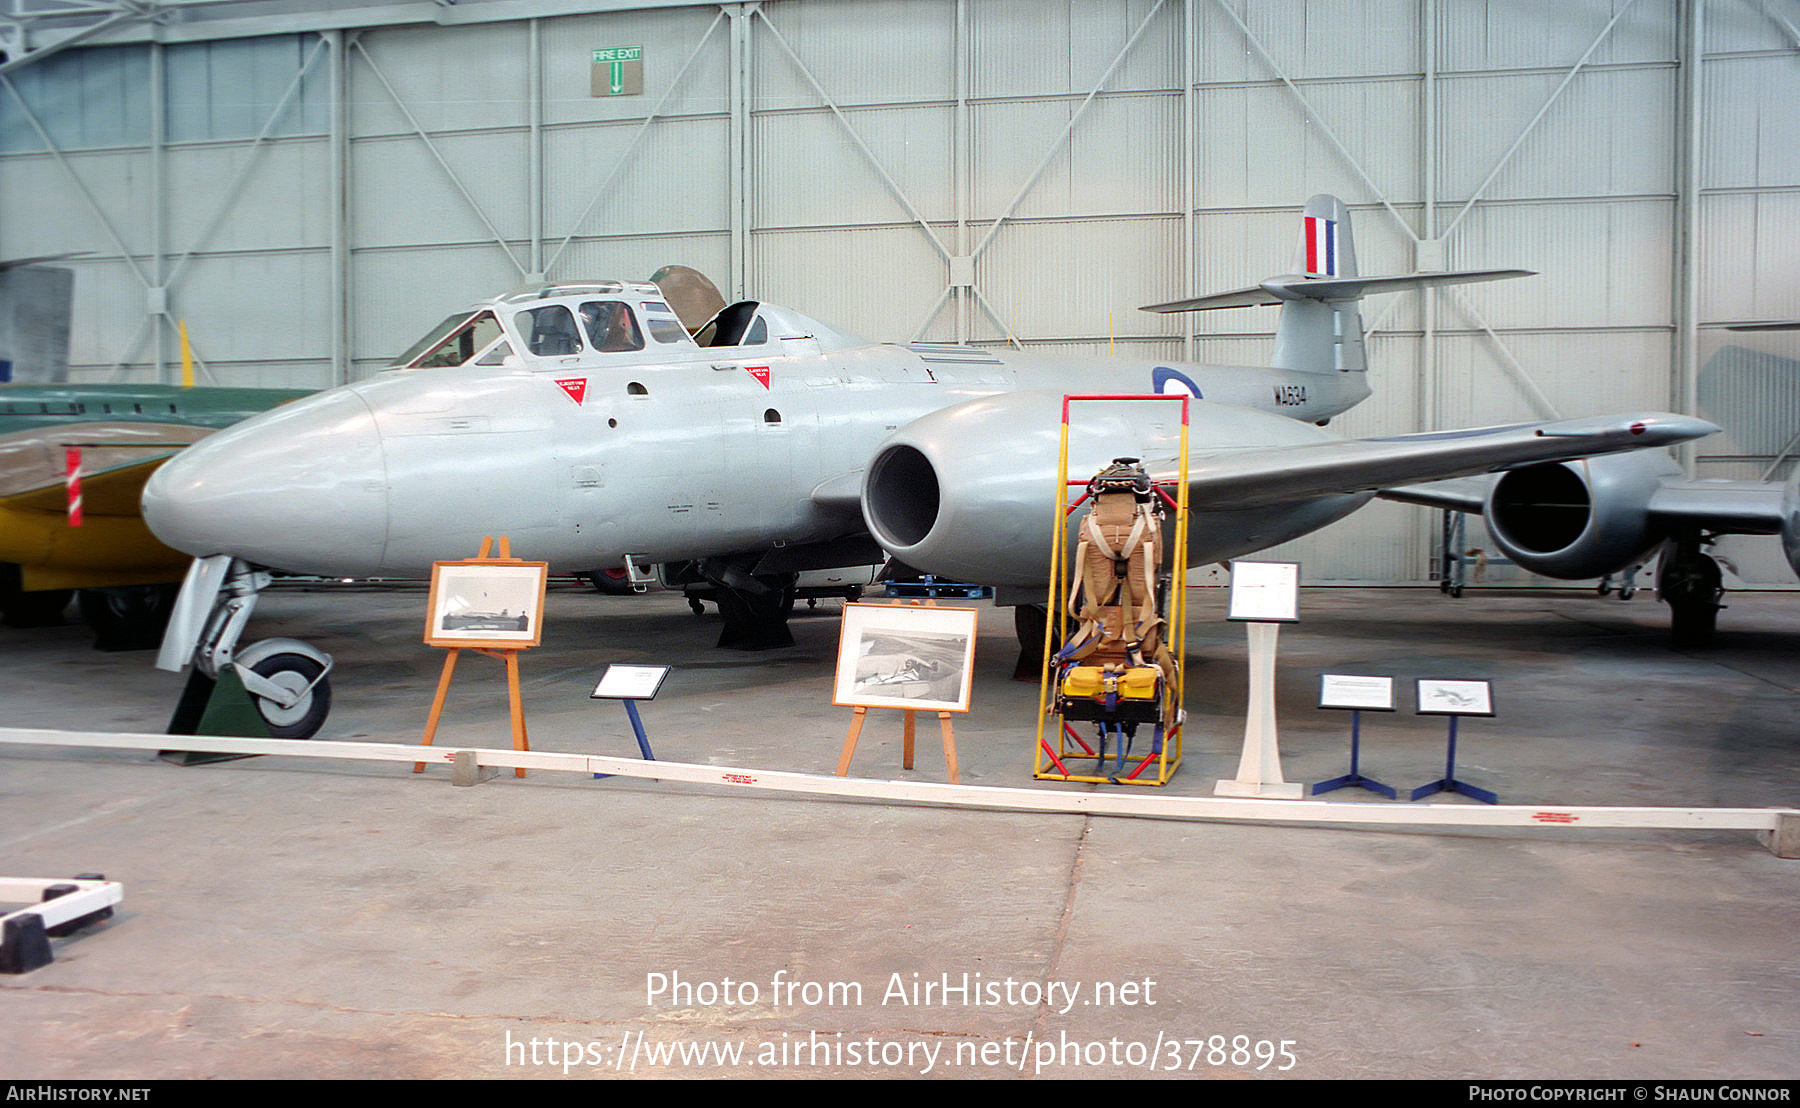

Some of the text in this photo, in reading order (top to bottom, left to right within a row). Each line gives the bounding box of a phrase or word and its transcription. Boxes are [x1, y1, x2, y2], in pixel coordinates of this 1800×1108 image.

[592, 48, 640, 60] FIRE EXIT
[1272, 385, 1307, 406] WA634
